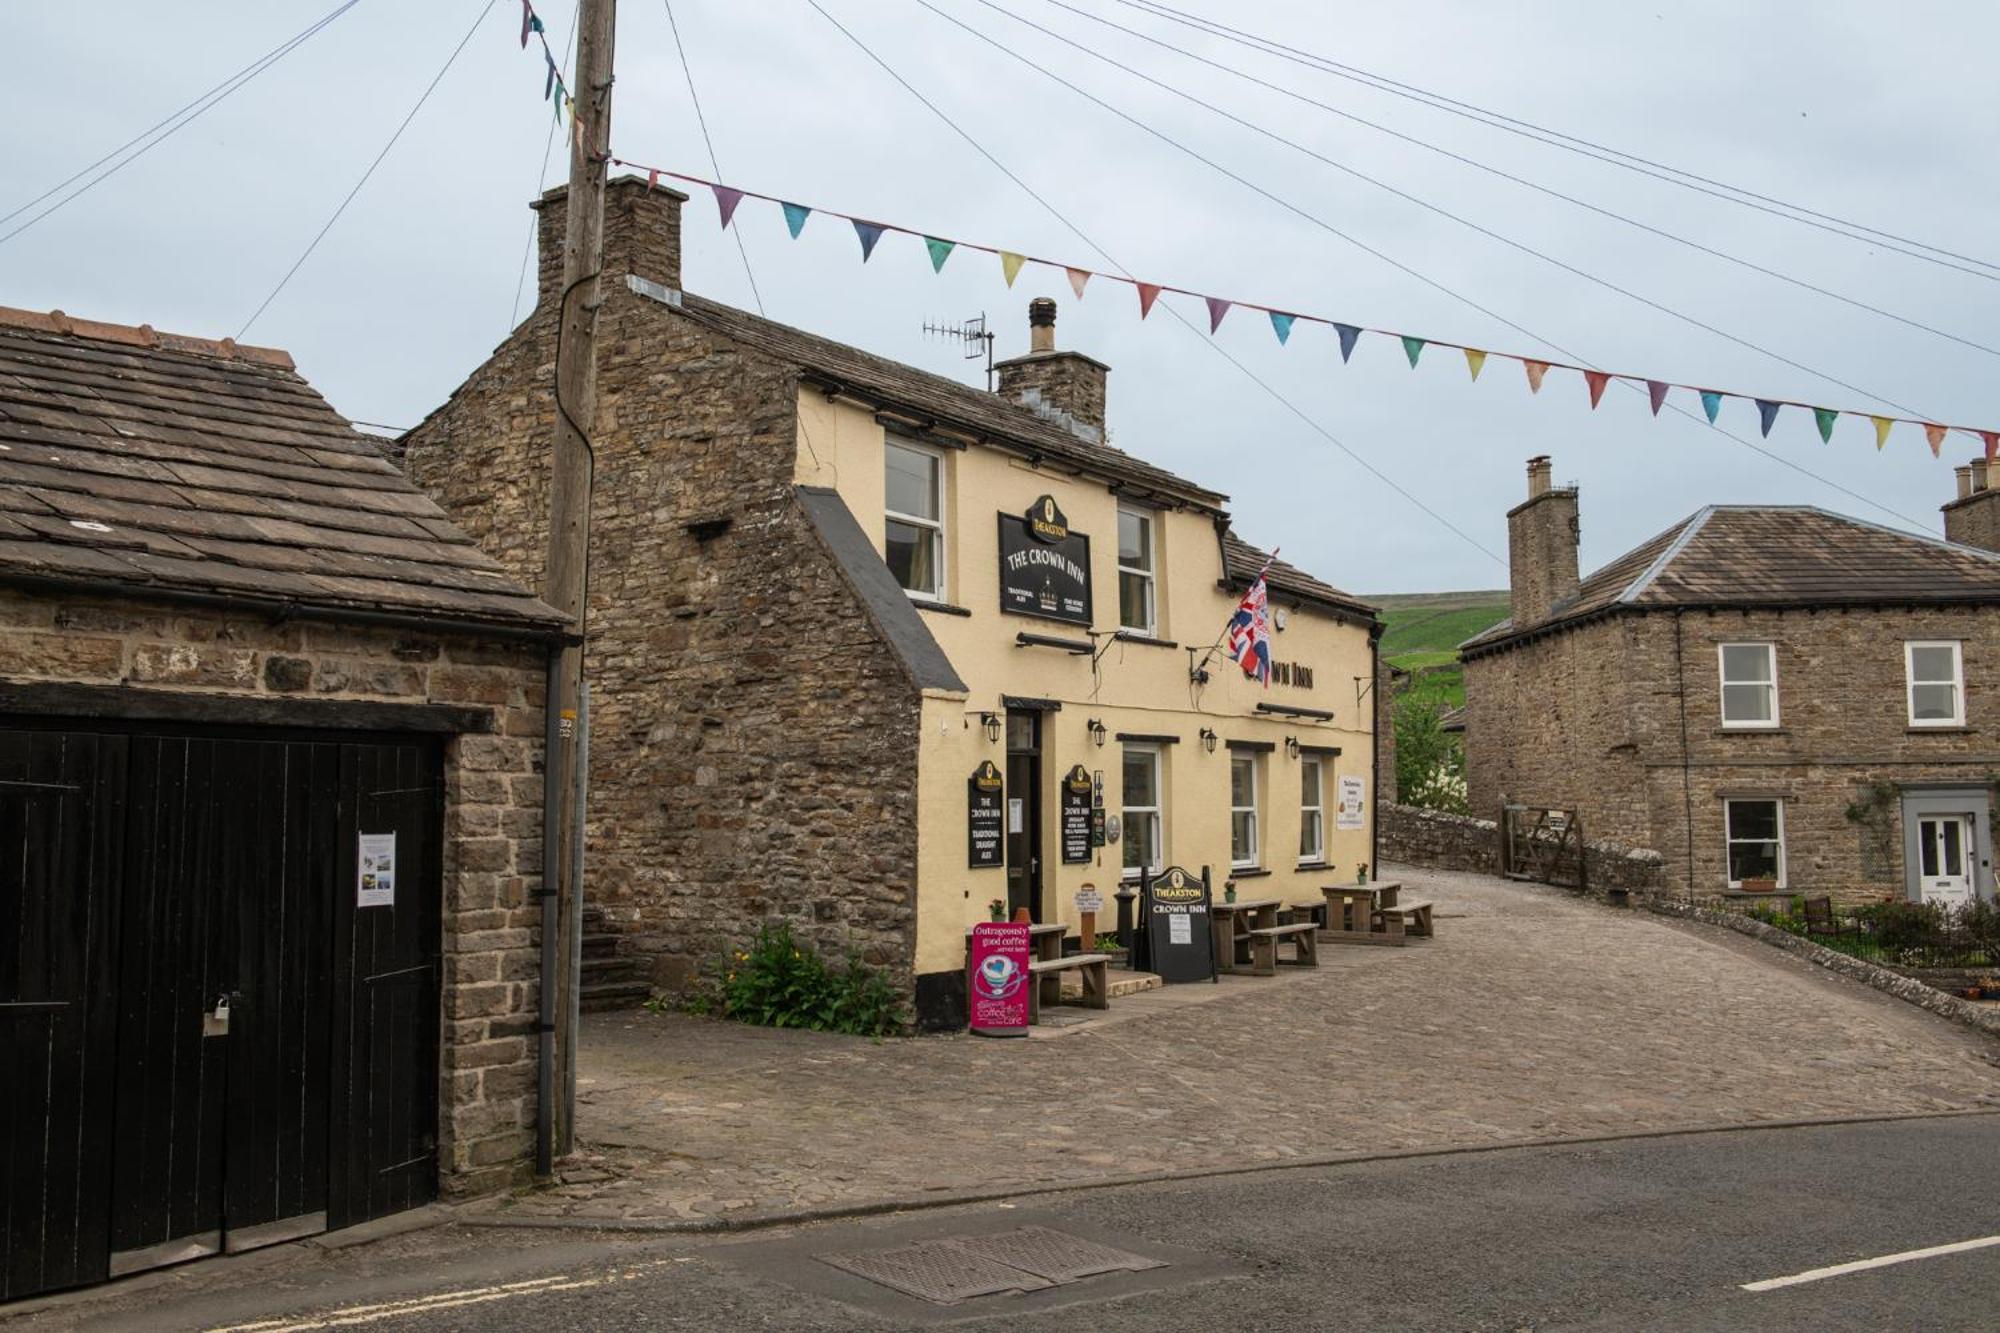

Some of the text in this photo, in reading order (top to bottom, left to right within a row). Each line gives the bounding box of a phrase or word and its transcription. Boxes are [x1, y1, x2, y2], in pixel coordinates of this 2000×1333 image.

[1034, 518, 1067, 538] THEAKSTON
[1008, 548, 1085, 586] THE CROWN INN
[981, 797, 991, 807] THE
[972, 809, 990, 818] CROWN
[1155, 888, 1201, 898] THEAKSTON
[1153, 904, 1206, 914] CROWN INN
[975, 927, 1027, 938] Outrageously
[982, 936, 1026, 948] good coffee
